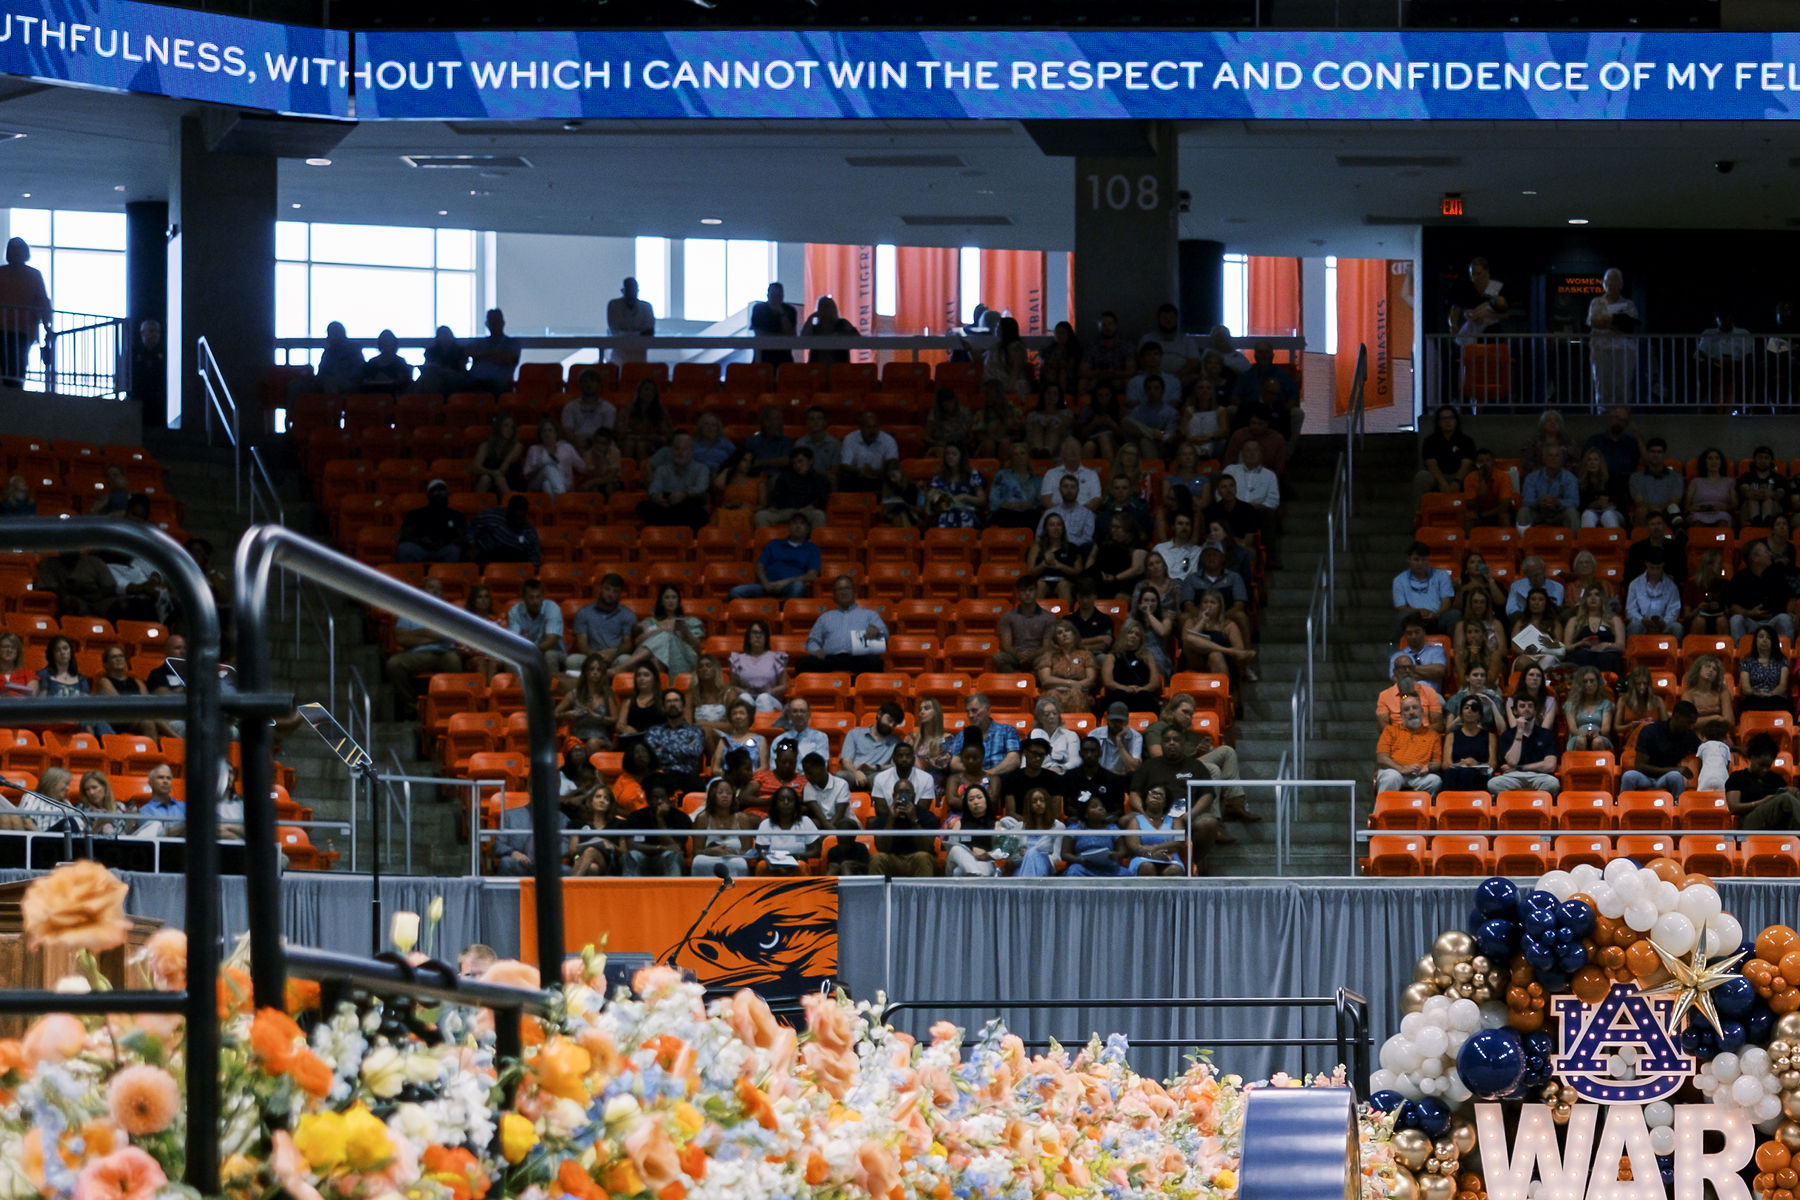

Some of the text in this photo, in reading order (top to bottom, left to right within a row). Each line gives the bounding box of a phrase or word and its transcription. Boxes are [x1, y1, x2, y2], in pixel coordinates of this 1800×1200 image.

[264, 51, 461, 89] WITHOUT
[471, 61, 609, 89] WHICH
[624, 61, 629, 89] I
[643, 61, 818, 89] CANNOT
[828, 61, 906, 89] WIN
[916, 61, 998, 89] THE
[1011, 61, 1203, 89] RESPECT
[1213, 61, 1302, 89] AND
[1313, 61, 1588, 89] CONFIDENCE
[1599, 61, 1654, 89] OF
[1667, 61, 1722, 90] MY
[1087, 173, 1160, 211] 108
[1442, 199, 1463, 216] EXIT
[1376, 299, 1387, 395] GYMNASTICS
